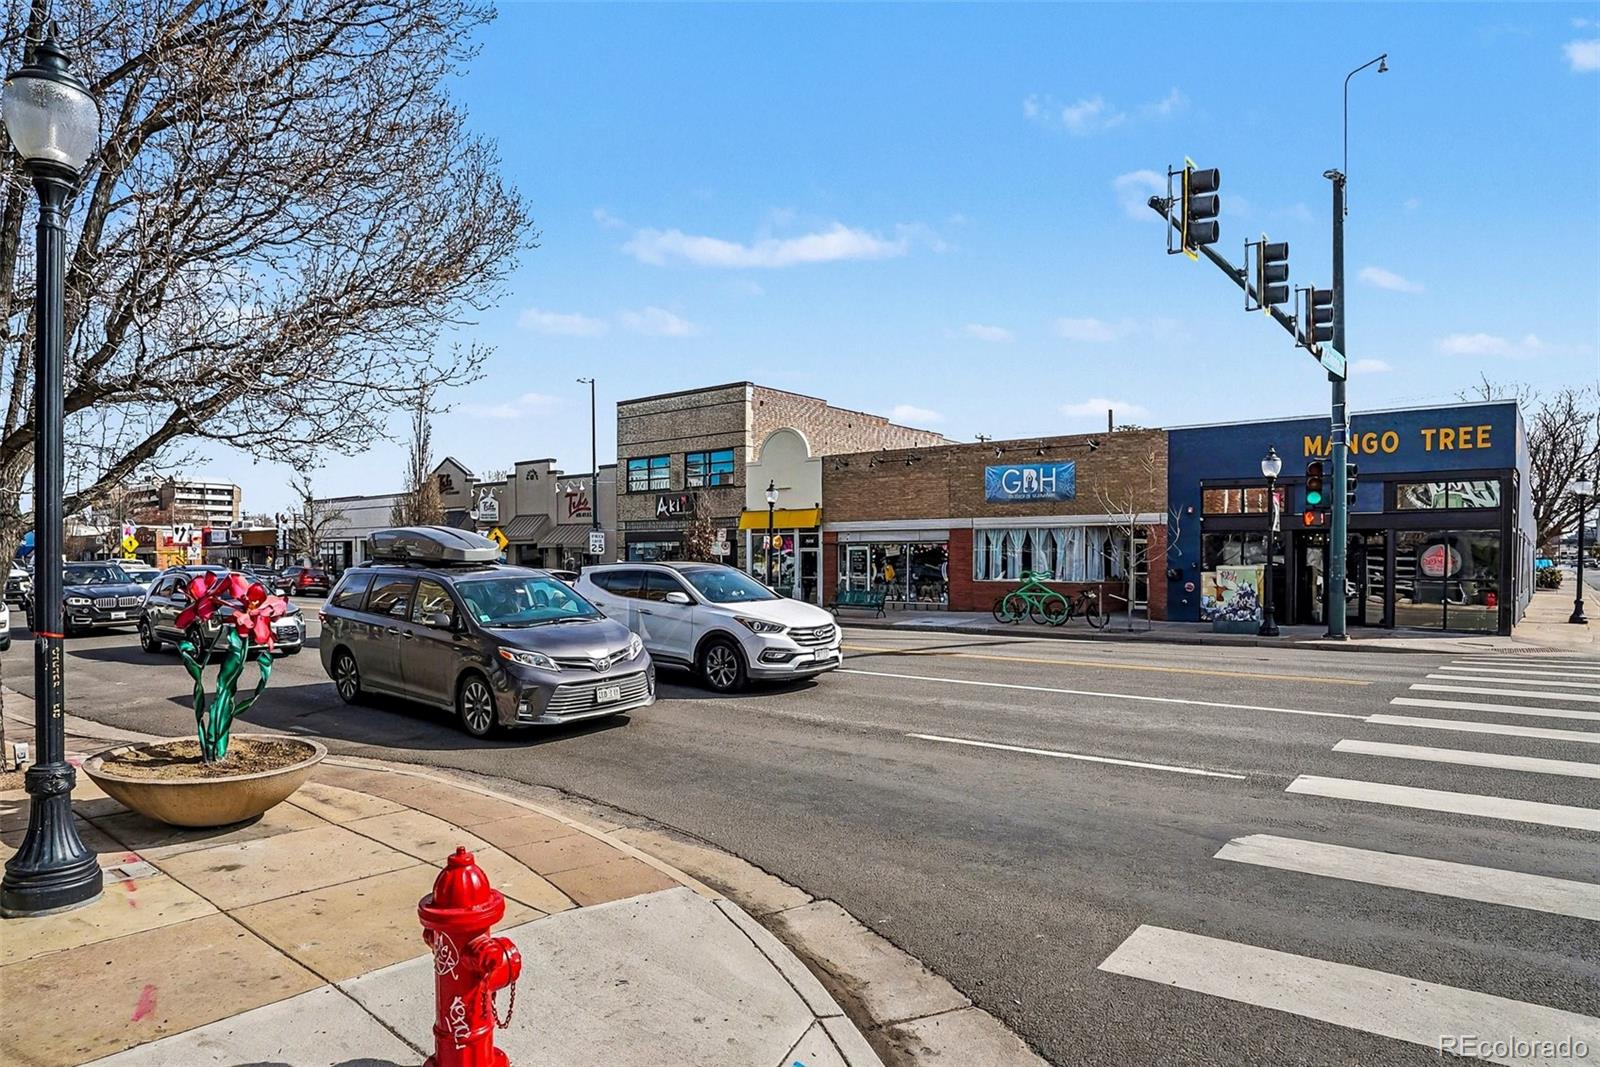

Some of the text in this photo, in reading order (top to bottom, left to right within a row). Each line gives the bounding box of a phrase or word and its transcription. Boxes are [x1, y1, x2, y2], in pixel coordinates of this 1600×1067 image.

[1421, 424, 1492, 452] TREE
[1002, 467, 1057, 494] GBH
[591, 543, 604, 553] 25
